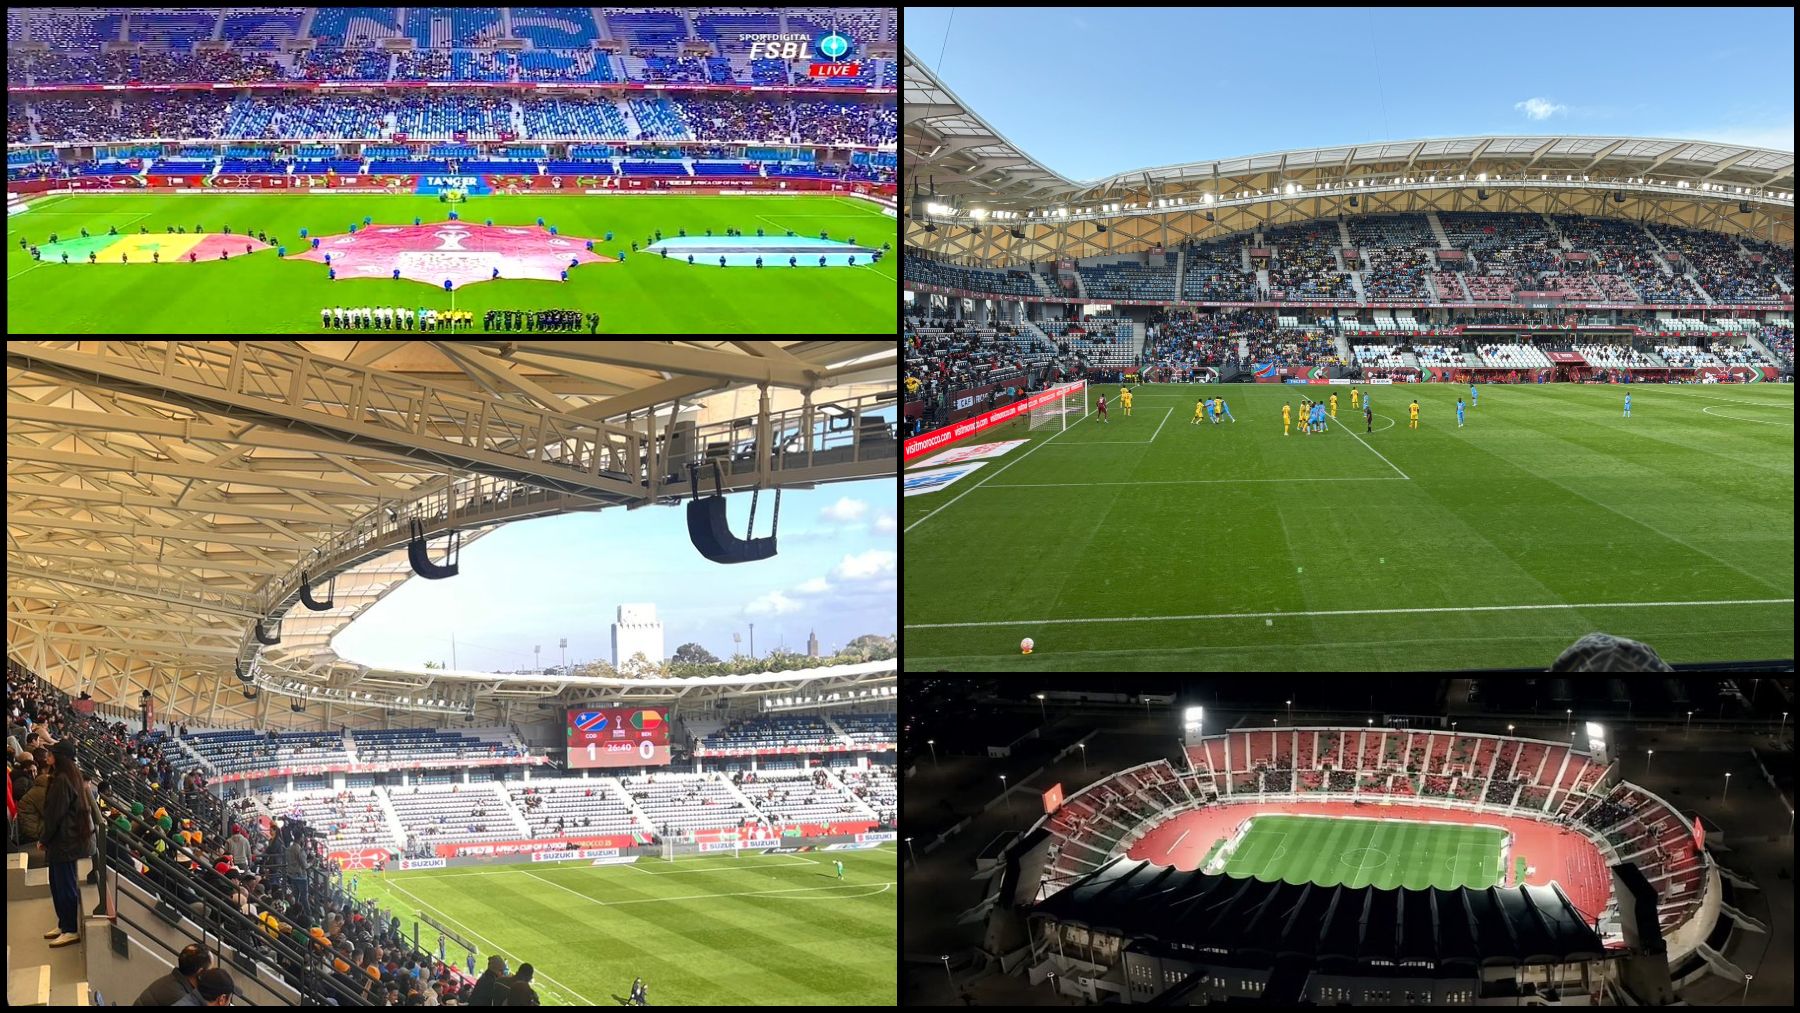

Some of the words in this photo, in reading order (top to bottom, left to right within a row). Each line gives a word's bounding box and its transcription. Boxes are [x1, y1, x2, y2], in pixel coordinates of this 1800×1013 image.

[906, 431, 951, 455] visitmorocco.com
[587, 743, 596, 760] 1
[607, 743, 632, 752] 26:40
[639, 740, 655, 759] 0
[543, 852, 573, 860] SUZUKI
[411, 859, 443, 868] SUZUKI
